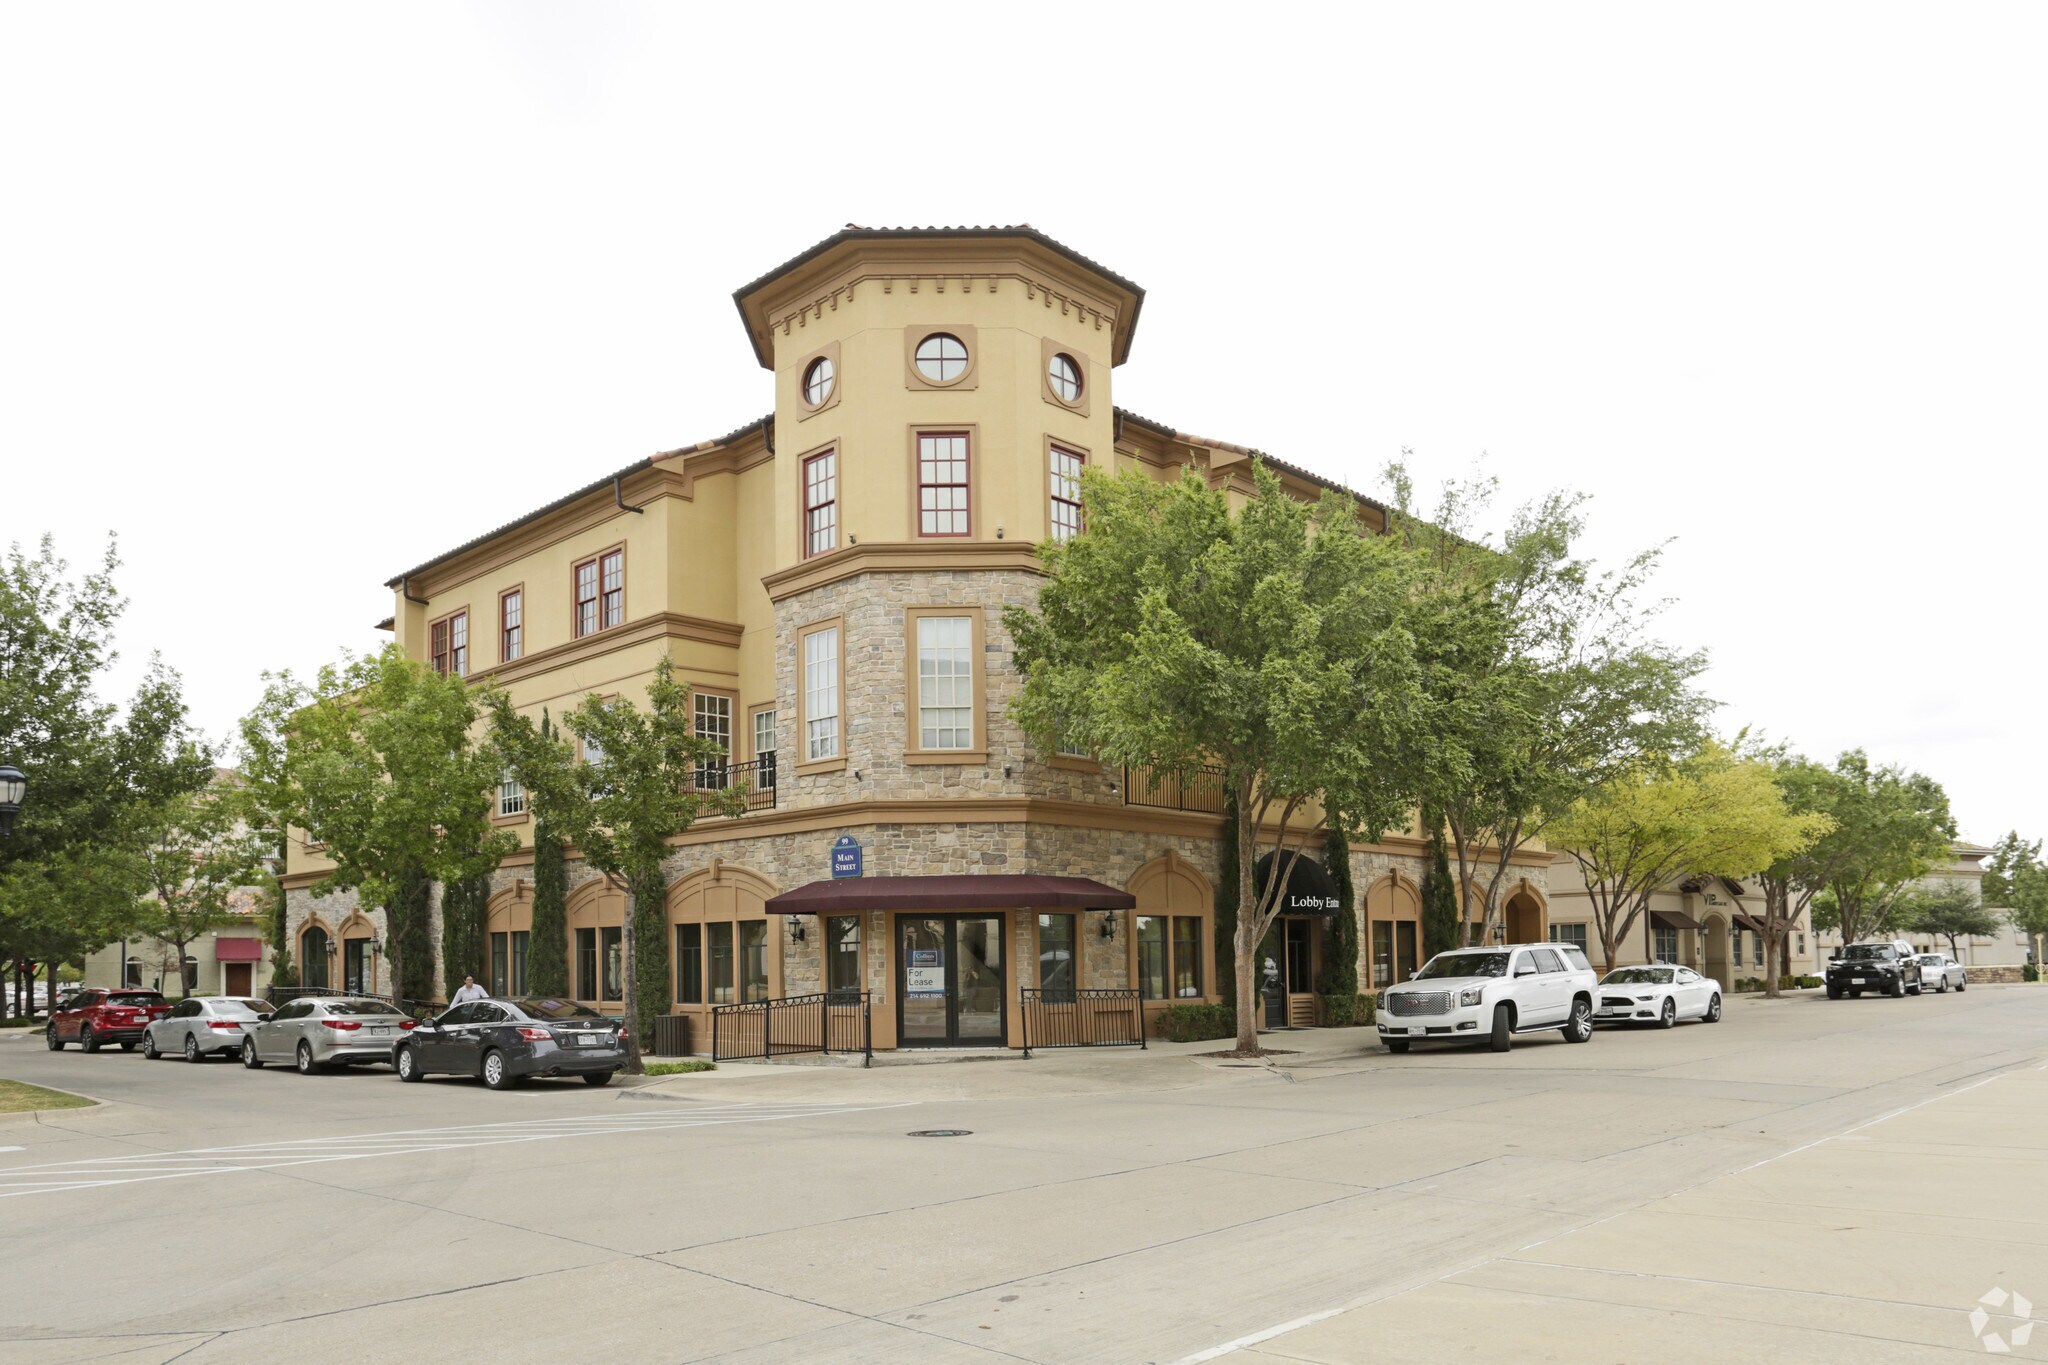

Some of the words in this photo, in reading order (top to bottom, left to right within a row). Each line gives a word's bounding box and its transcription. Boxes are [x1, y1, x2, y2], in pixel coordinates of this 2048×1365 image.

[1291, 896, 1324, 910] Lobby
[1703, 894, 1716, 905] VIP
[908, 968, 924, 977] For
[908, 978, 934, 986] Lease
